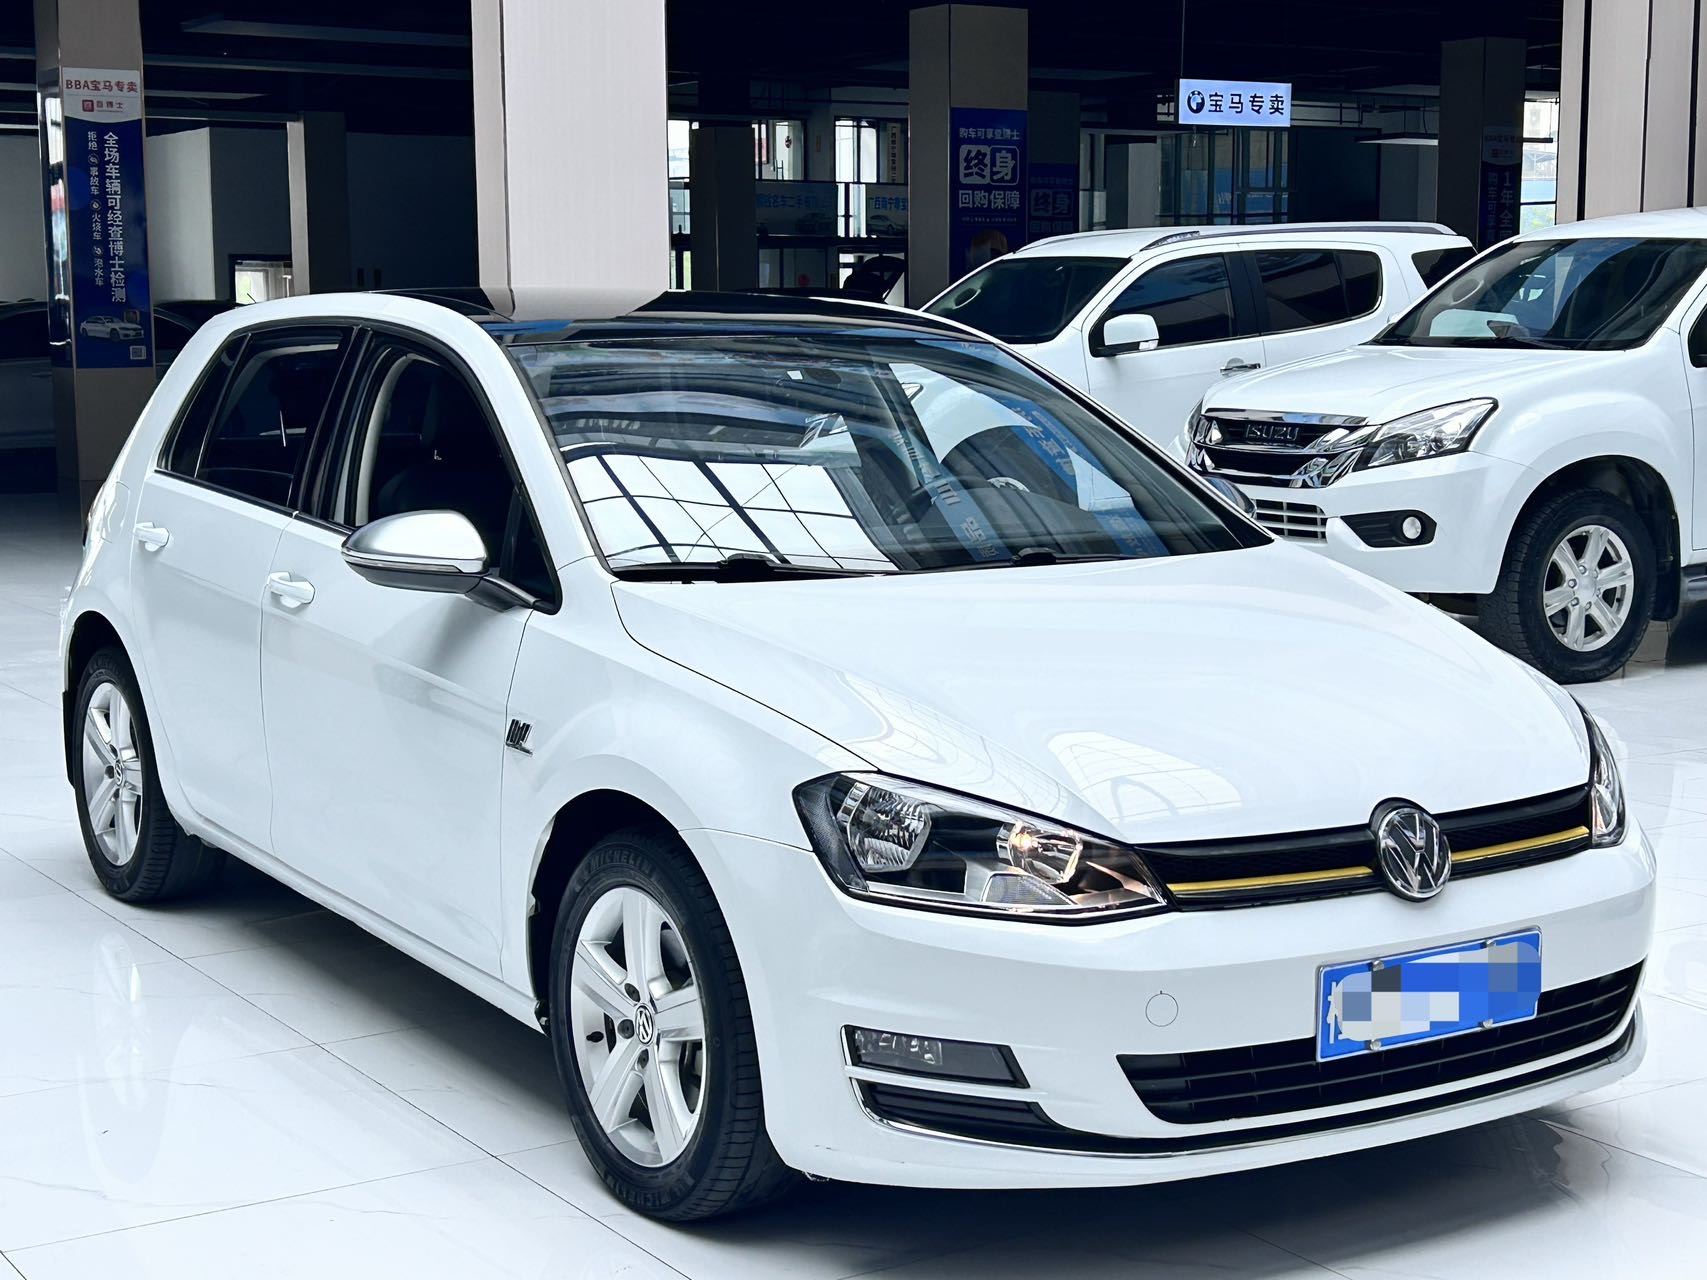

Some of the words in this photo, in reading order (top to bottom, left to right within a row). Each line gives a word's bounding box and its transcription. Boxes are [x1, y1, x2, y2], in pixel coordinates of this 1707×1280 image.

[65, 79, 138, 93] BBA宝马专卖
[1208, 92, 1285, 115] 宝马专卖
[87, 130, 98, 151] 拒绝
[963, 148, 1016, 181] 终身
[89, 166, 100, 195] 事故车
[958, 189, 1021, 210] 回购保障
[91, 212, 102, 241] 火烧车
[103, 132, 127, 303] 全场车辆可经查博士检测
[1245, 424, 1300, 441] ISUZU
